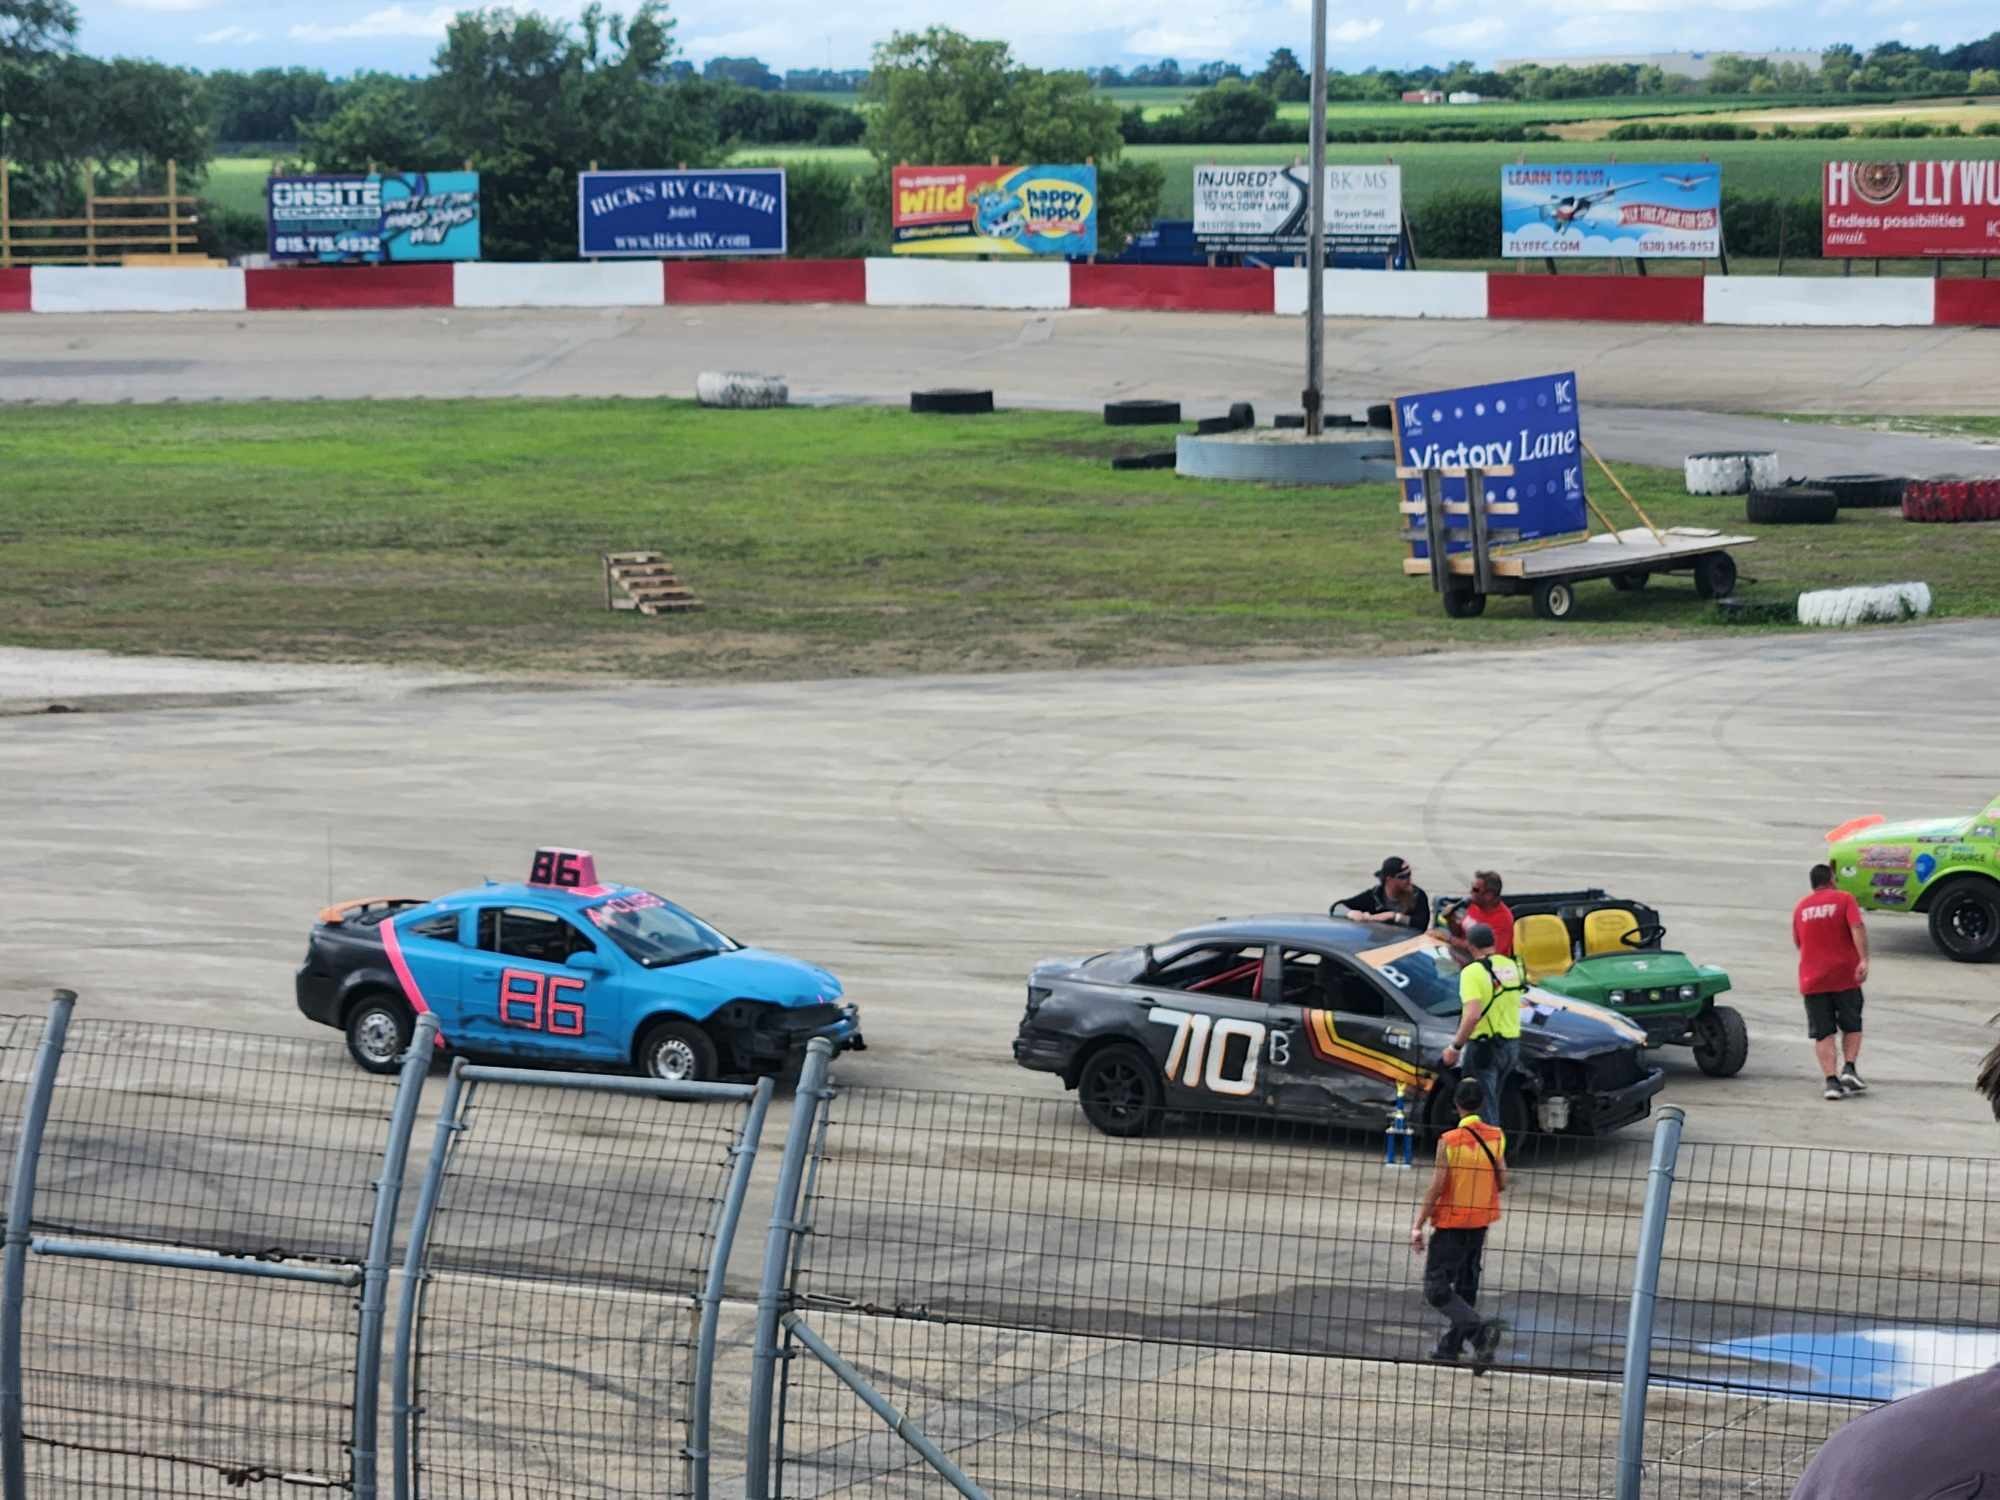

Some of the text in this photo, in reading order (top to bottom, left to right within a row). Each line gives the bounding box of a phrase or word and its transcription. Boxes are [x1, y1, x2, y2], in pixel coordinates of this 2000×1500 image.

[1198, 171, 1277, 186] INJURED?
[1508, 171, 1551, 186] LEARN
[1555, 171, 1572, 186] TO
[273, 182, 380, 206] ONSITE
[590, 180, 776, 216] RICK'S RV CENTER
[900, 184, 965, 215] Wild
[1027, 188, 1083, 206] happy
[1203, 190, 1289, 200] LET US DRIVE YOU
[1030, 204, 1080, 221] hippo
[1204, 202, 1290, 211] TO VICTORY LANE
[1828, 211, 1965, 230] Endless possibilities
[1827, 231, 1867, 245] await.
[1409, 428, 1576, 469] Victory Lane
[529, 851, 581, 888] 86
[1801, 904, 1837, 922] STAFF
[499, 967, 586, 1037] 86
[1147, 1006, 1290, 1096] 710 B
